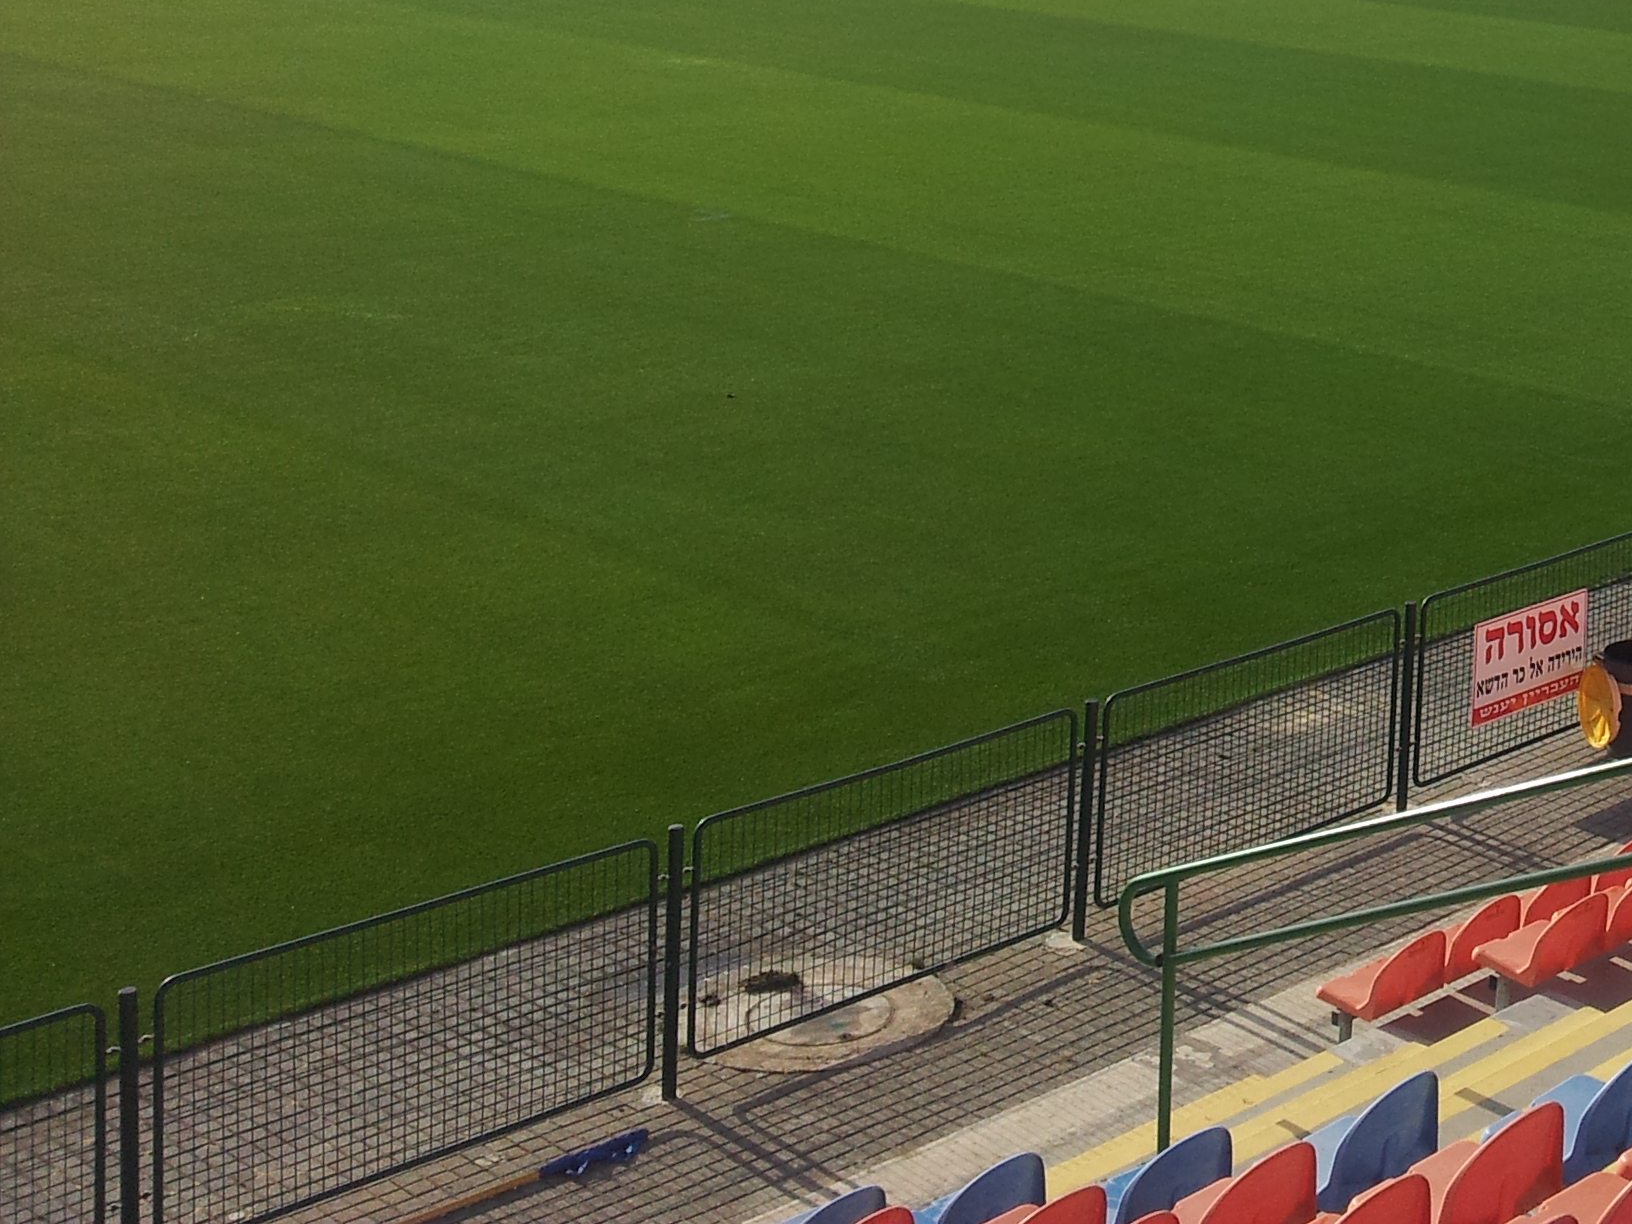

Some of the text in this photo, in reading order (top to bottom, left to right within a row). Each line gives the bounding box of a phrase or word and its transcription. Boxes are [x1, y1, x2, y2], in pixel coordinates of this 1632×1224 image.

[1485, 601, 1580, 665] אסורה
[1476, 646, 1582, 699] הירידה אל כר הדשא
[1479, 674, 1580, 719] העבריין יענש
